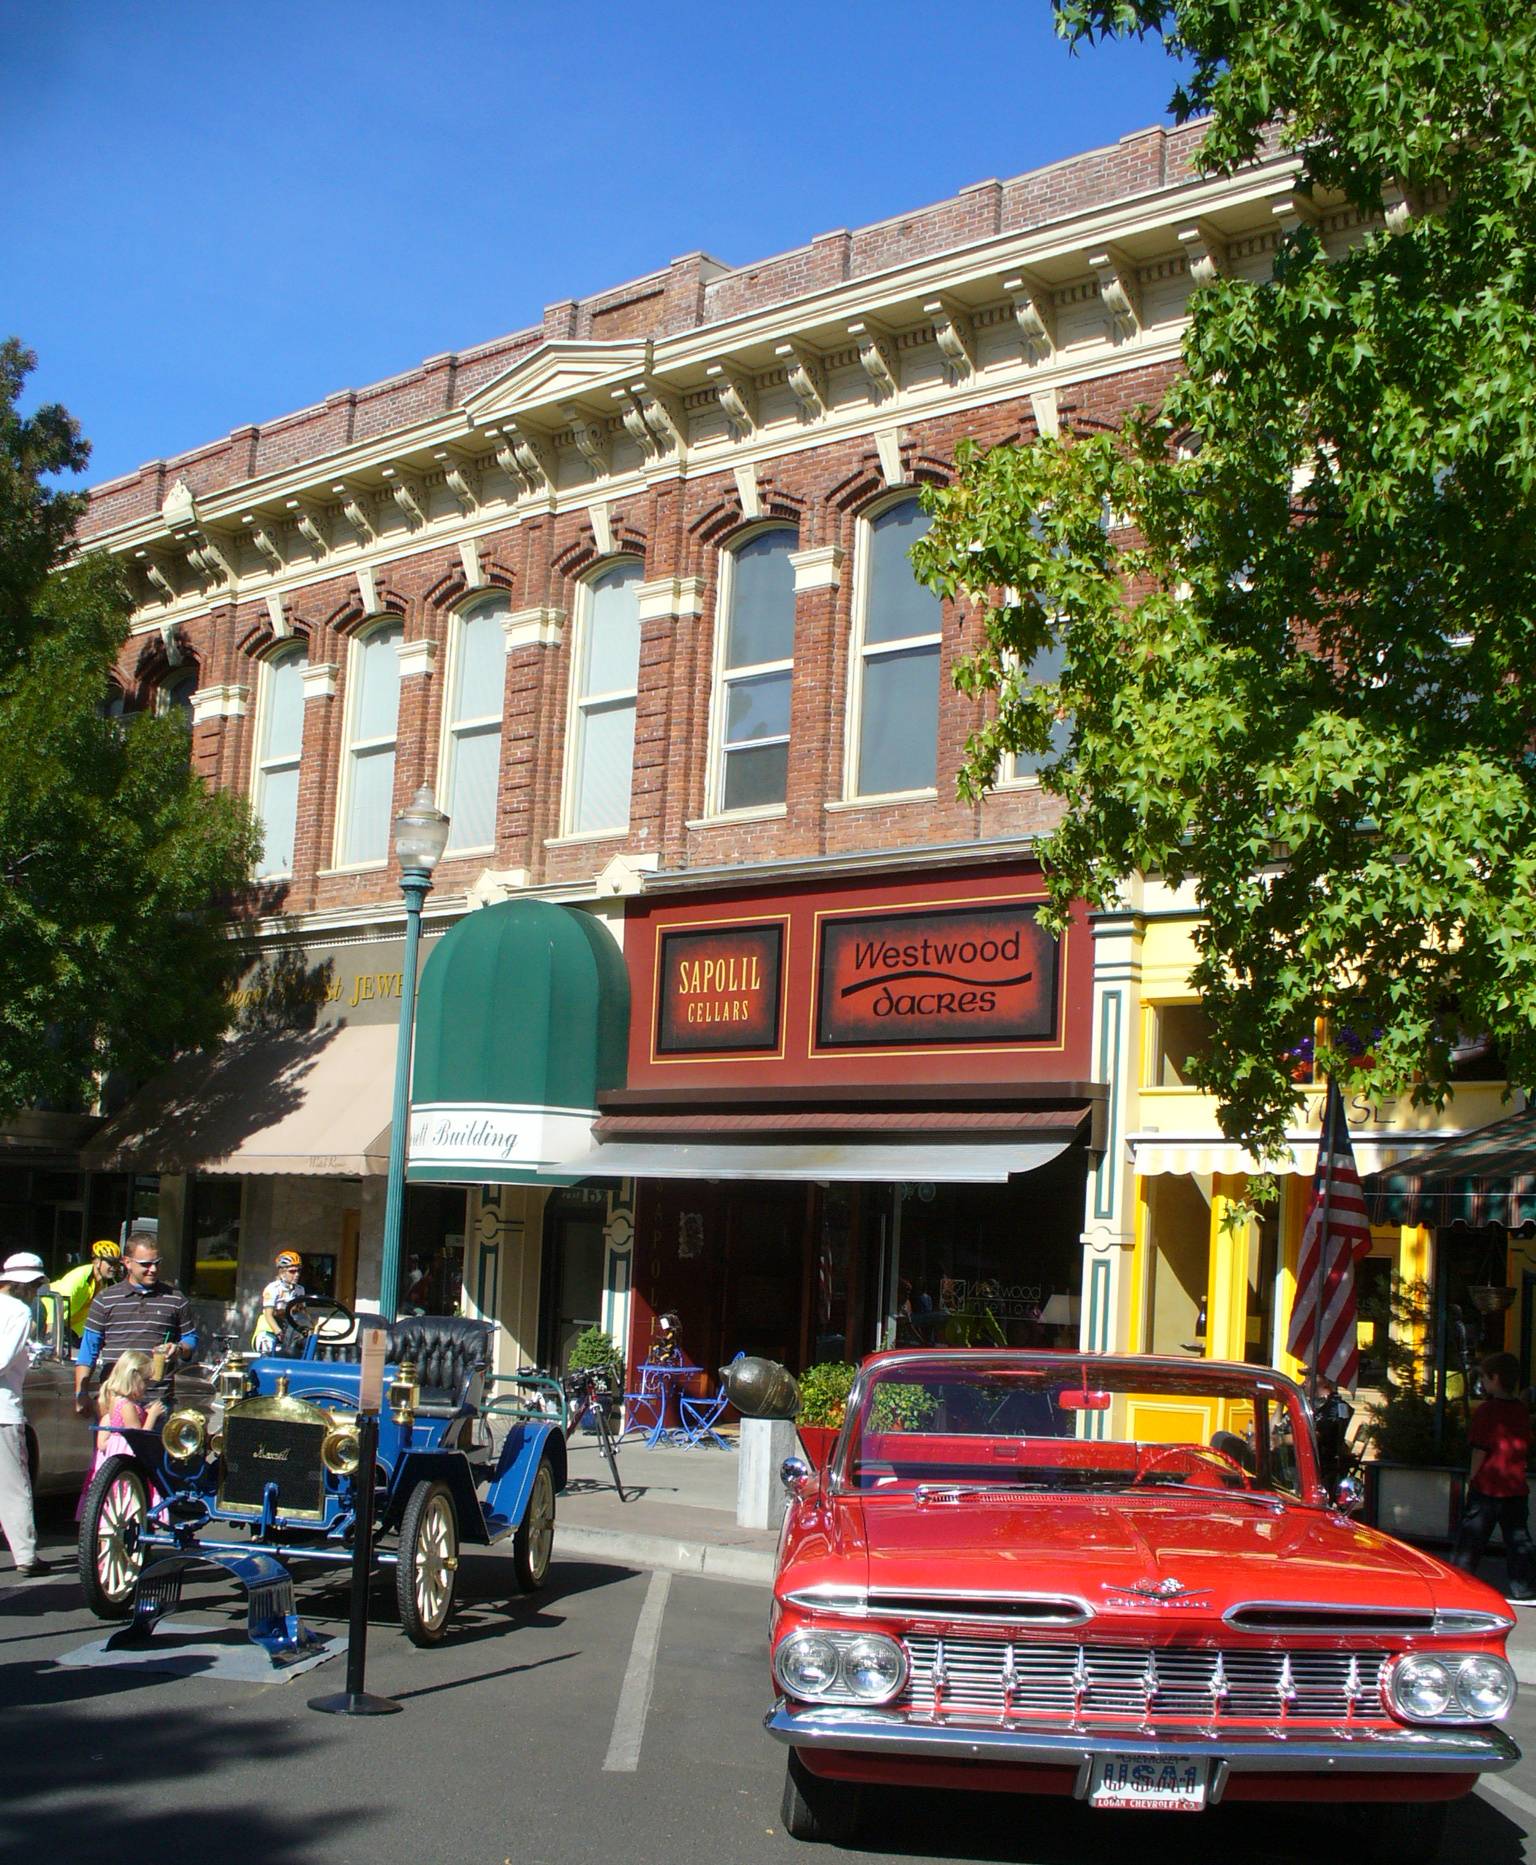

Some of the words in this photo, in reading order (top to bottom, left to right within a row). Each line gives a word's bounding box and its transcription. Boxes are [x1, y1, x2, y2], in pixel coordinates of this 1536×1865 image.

[854, 931, 1021, 970] Westwood
[679, 956, 761, 995] SAPOLIL
[687, 999, 750, 1024] CELLARS
[432, 1118, 519, 1160] Building
[1098, 1799, 1126, 1808] LOGAN
[1129, 1799, 1180, 1809] CHEVROLET
